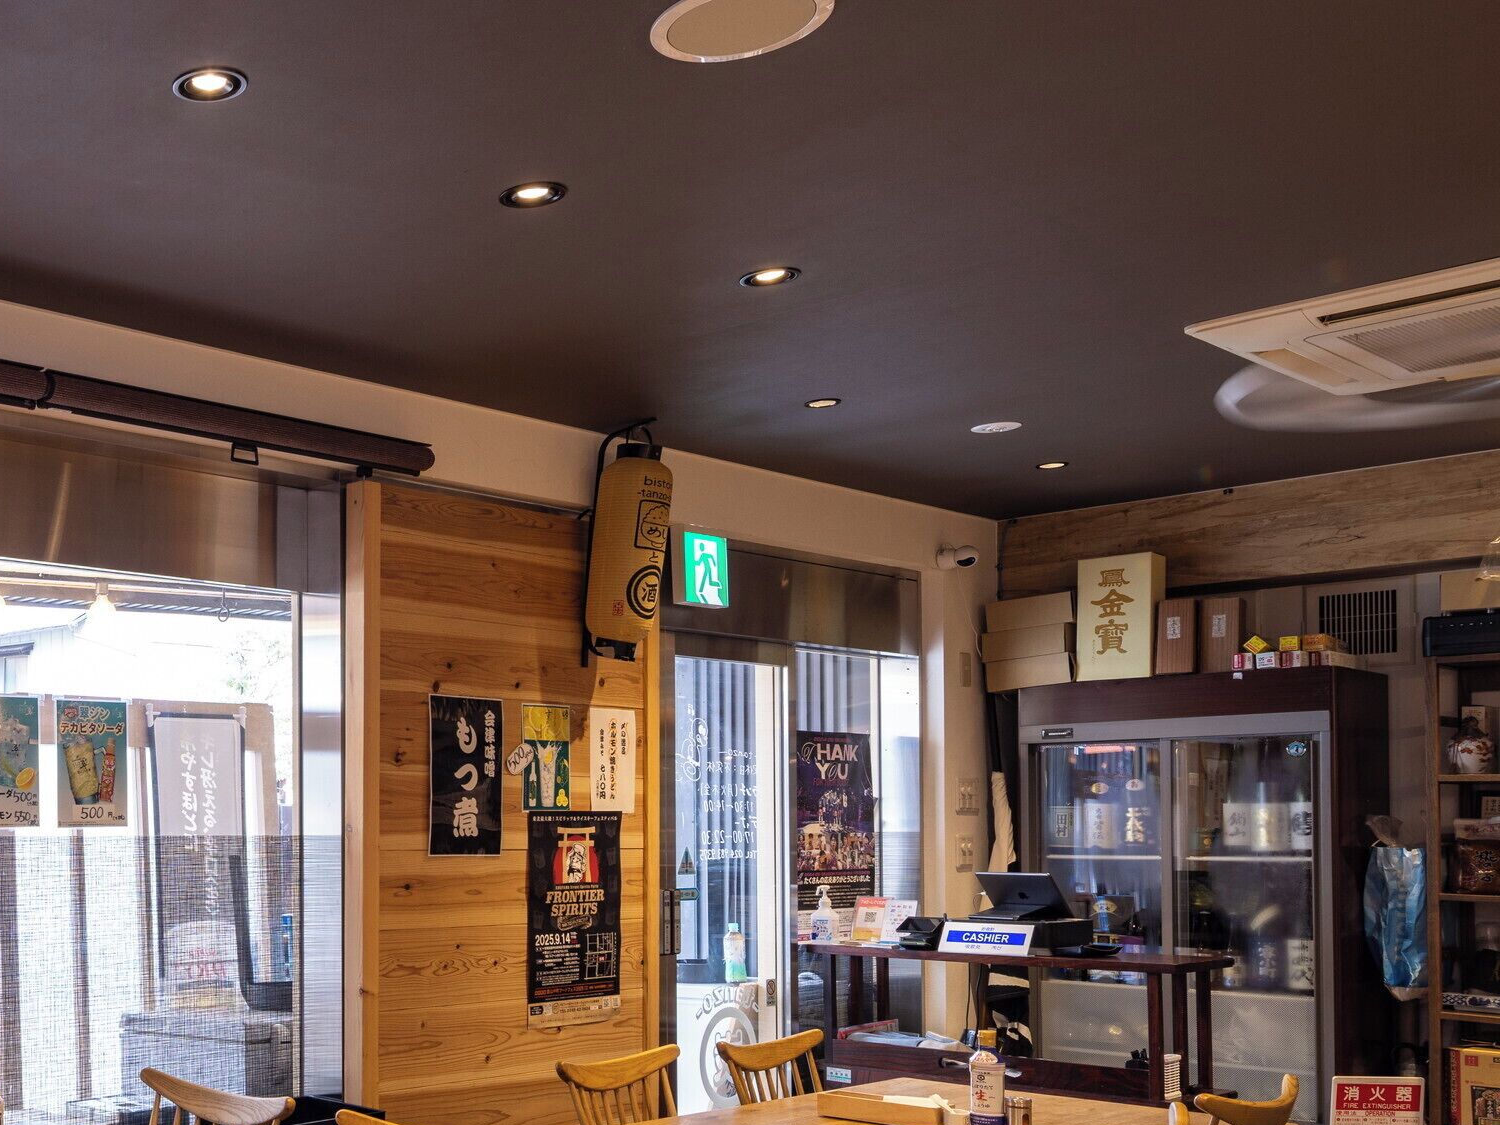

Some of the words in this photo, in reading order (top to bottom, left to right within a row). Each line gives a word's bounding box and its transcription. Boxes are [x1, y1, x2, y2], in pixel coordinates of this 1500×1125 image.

[642, 582, 658, 603] 酒
[60, 721, 124, 735] デカビタソーダ
[801, 741, 858, 764] THANK
[453, 717, 479, 838] もつ煮
[816, 761, 848, 782] YOU
[13, 791, 33, 803] 500
[14, 811, 31, 822] 550
[80, 807, 104, 819] 500
[545, 889, 605, 904] FRONTIER
[551, 903, 598, 917] SPIRITS
[535, 933, 570, 946] 2025.9.14
[962, 933, 1009, 943] CASHIER
[975, 1090, 988, 1101] 生
[1343, 1086, 1412, 1101] 消火器
